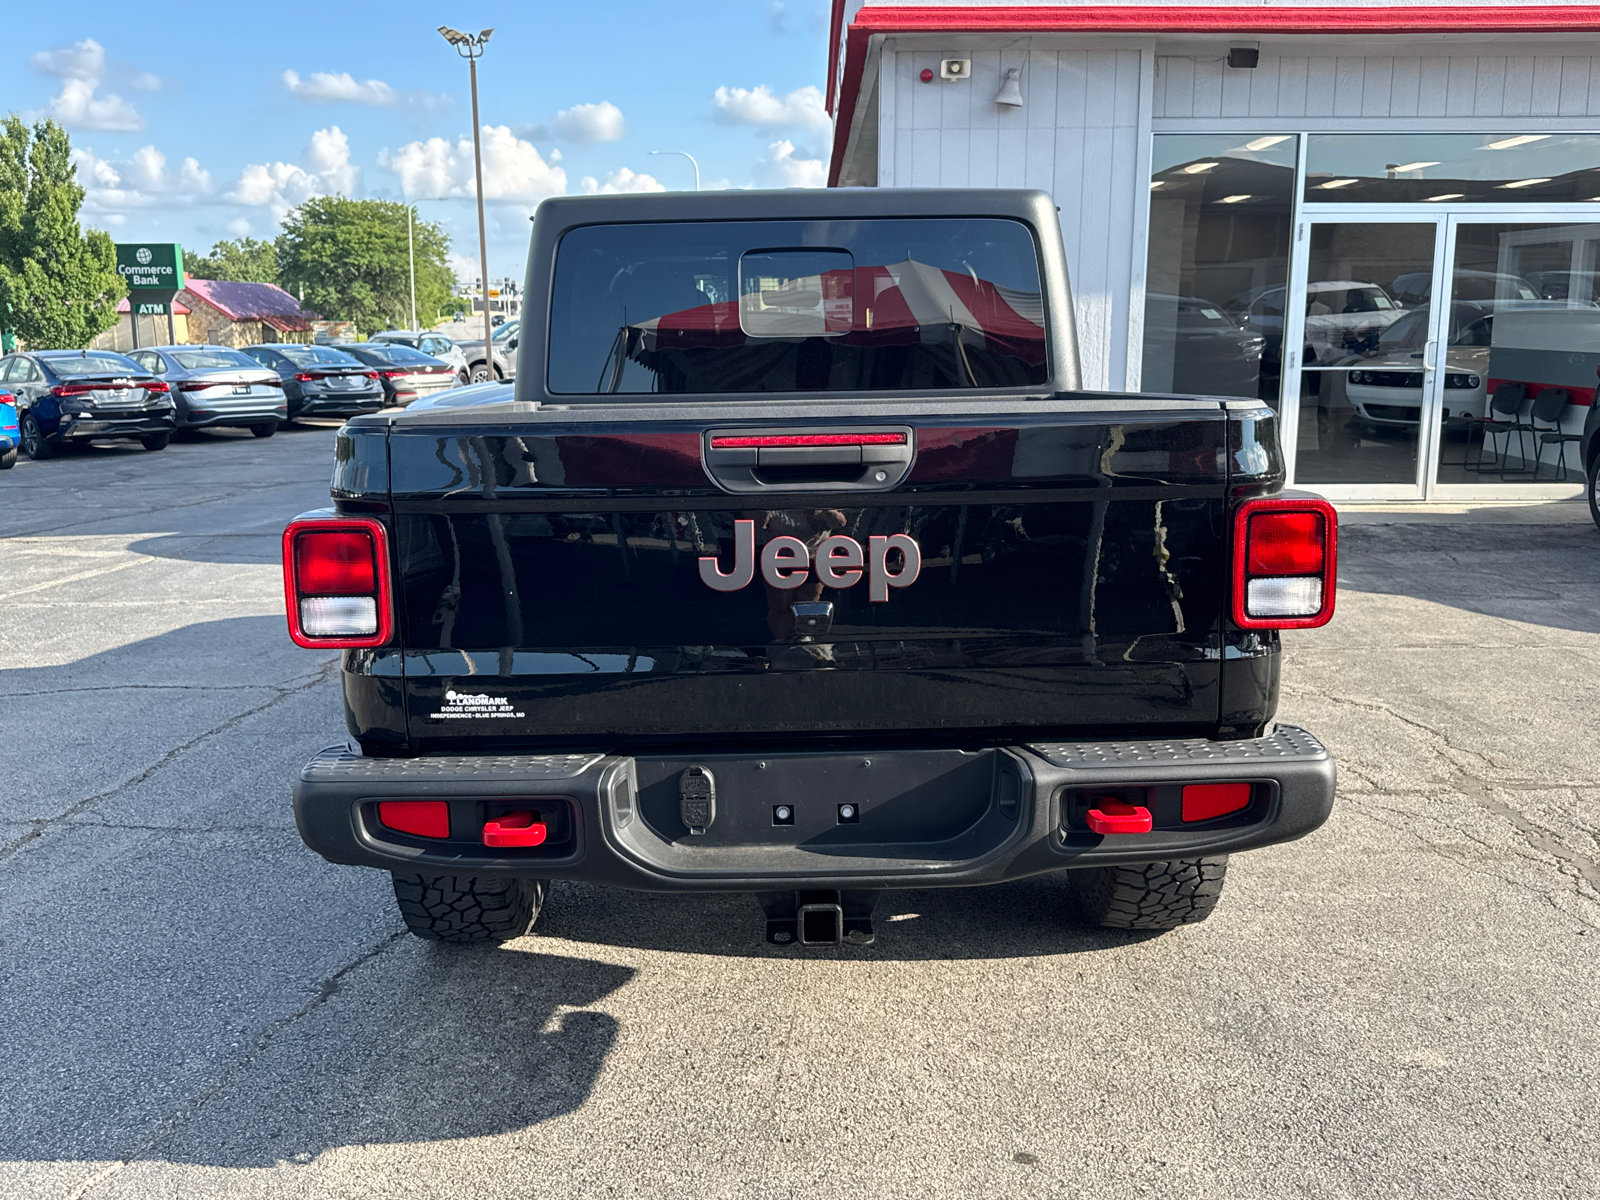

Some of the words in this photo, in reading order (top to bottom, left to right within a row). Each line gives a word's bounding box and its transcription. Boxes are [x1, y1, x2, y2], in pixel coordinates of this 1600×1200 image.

[118, 264, 173, 275] Commerce
[133, 275, 159, 285] Bank
[139, 304, 164, 314] ATM
[698, 519, 921, 603] Jeep
[456, 697, 508, 705] LANDMARK
